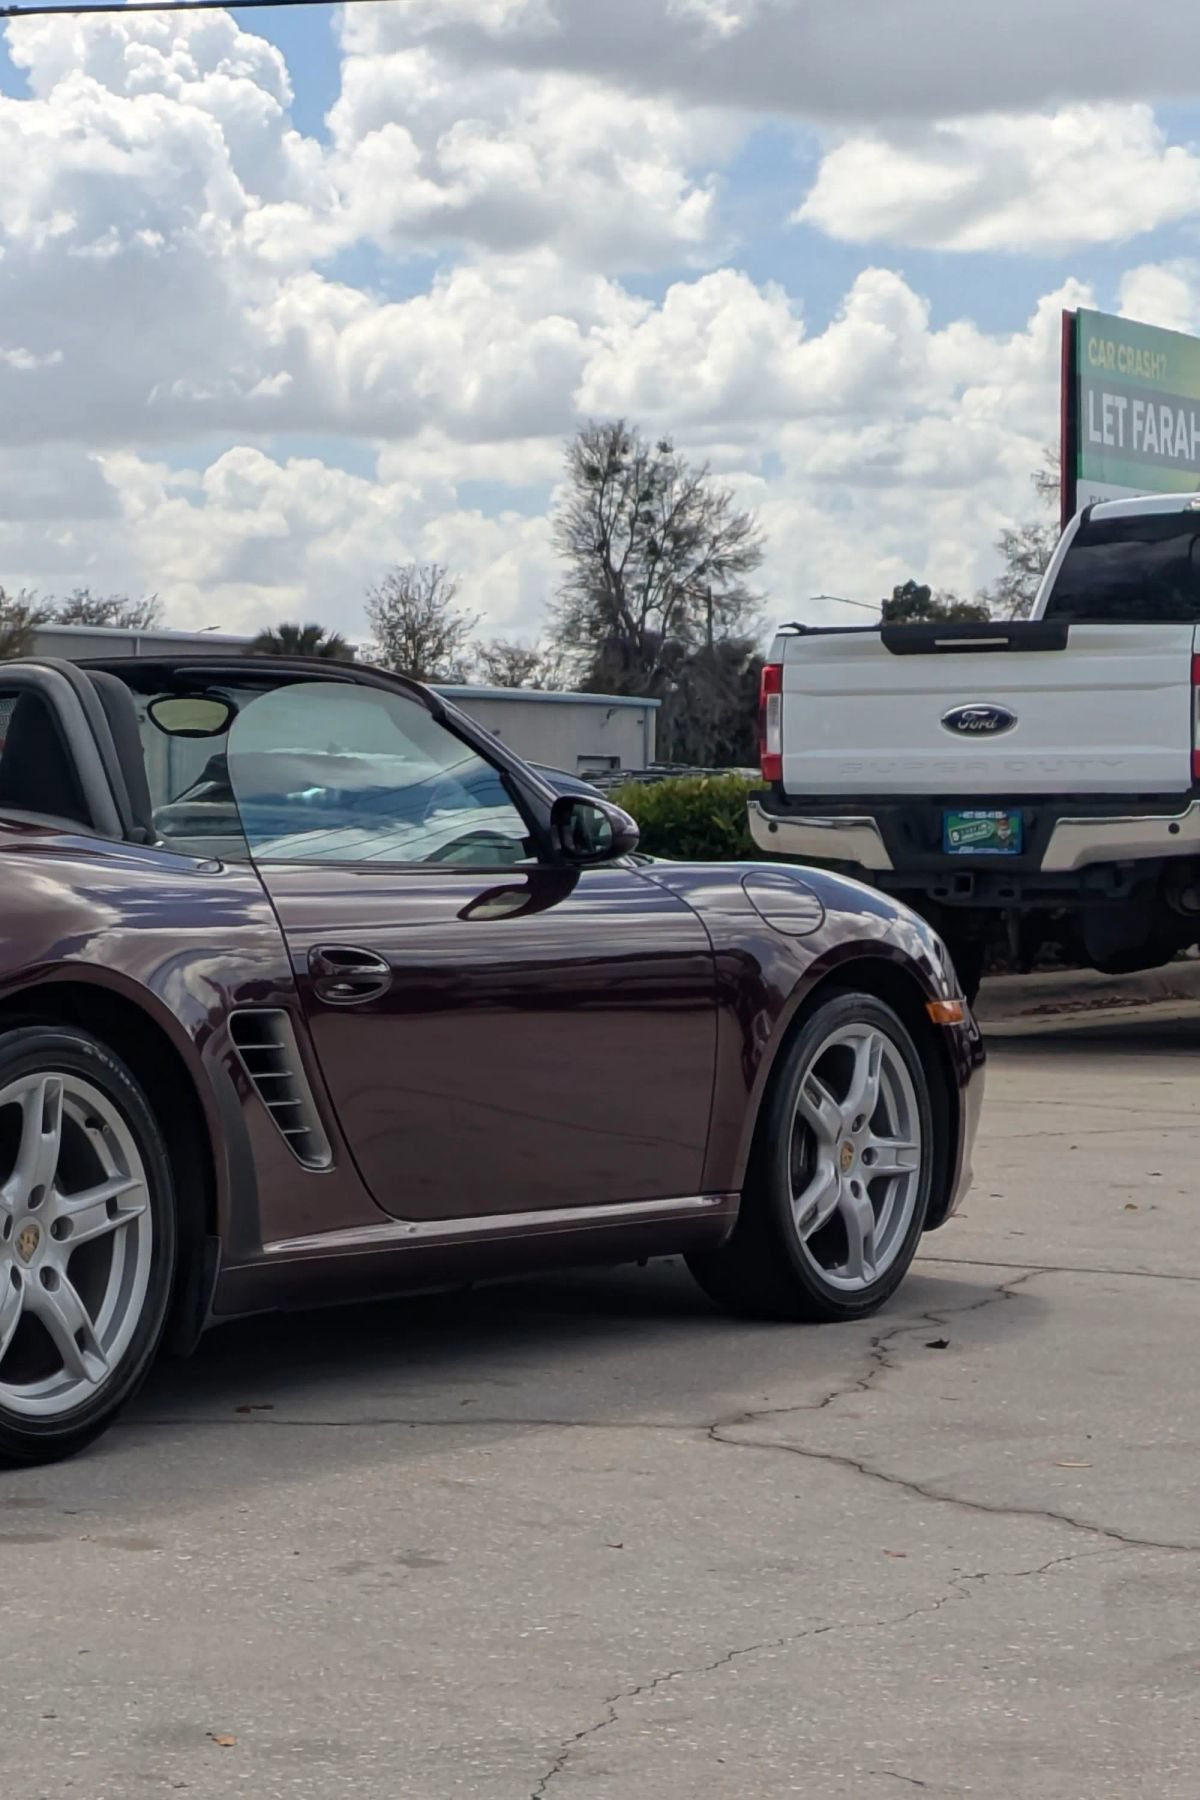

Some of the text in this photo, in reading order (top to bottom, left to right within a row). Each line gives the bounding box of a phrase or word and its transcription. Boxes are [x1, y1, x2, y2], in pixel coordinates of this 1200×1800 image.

[1088, 337, 1114, 369] CAR
[1089, 390, 1127, 447] LET
[957, 710, 999, 729] Ford
